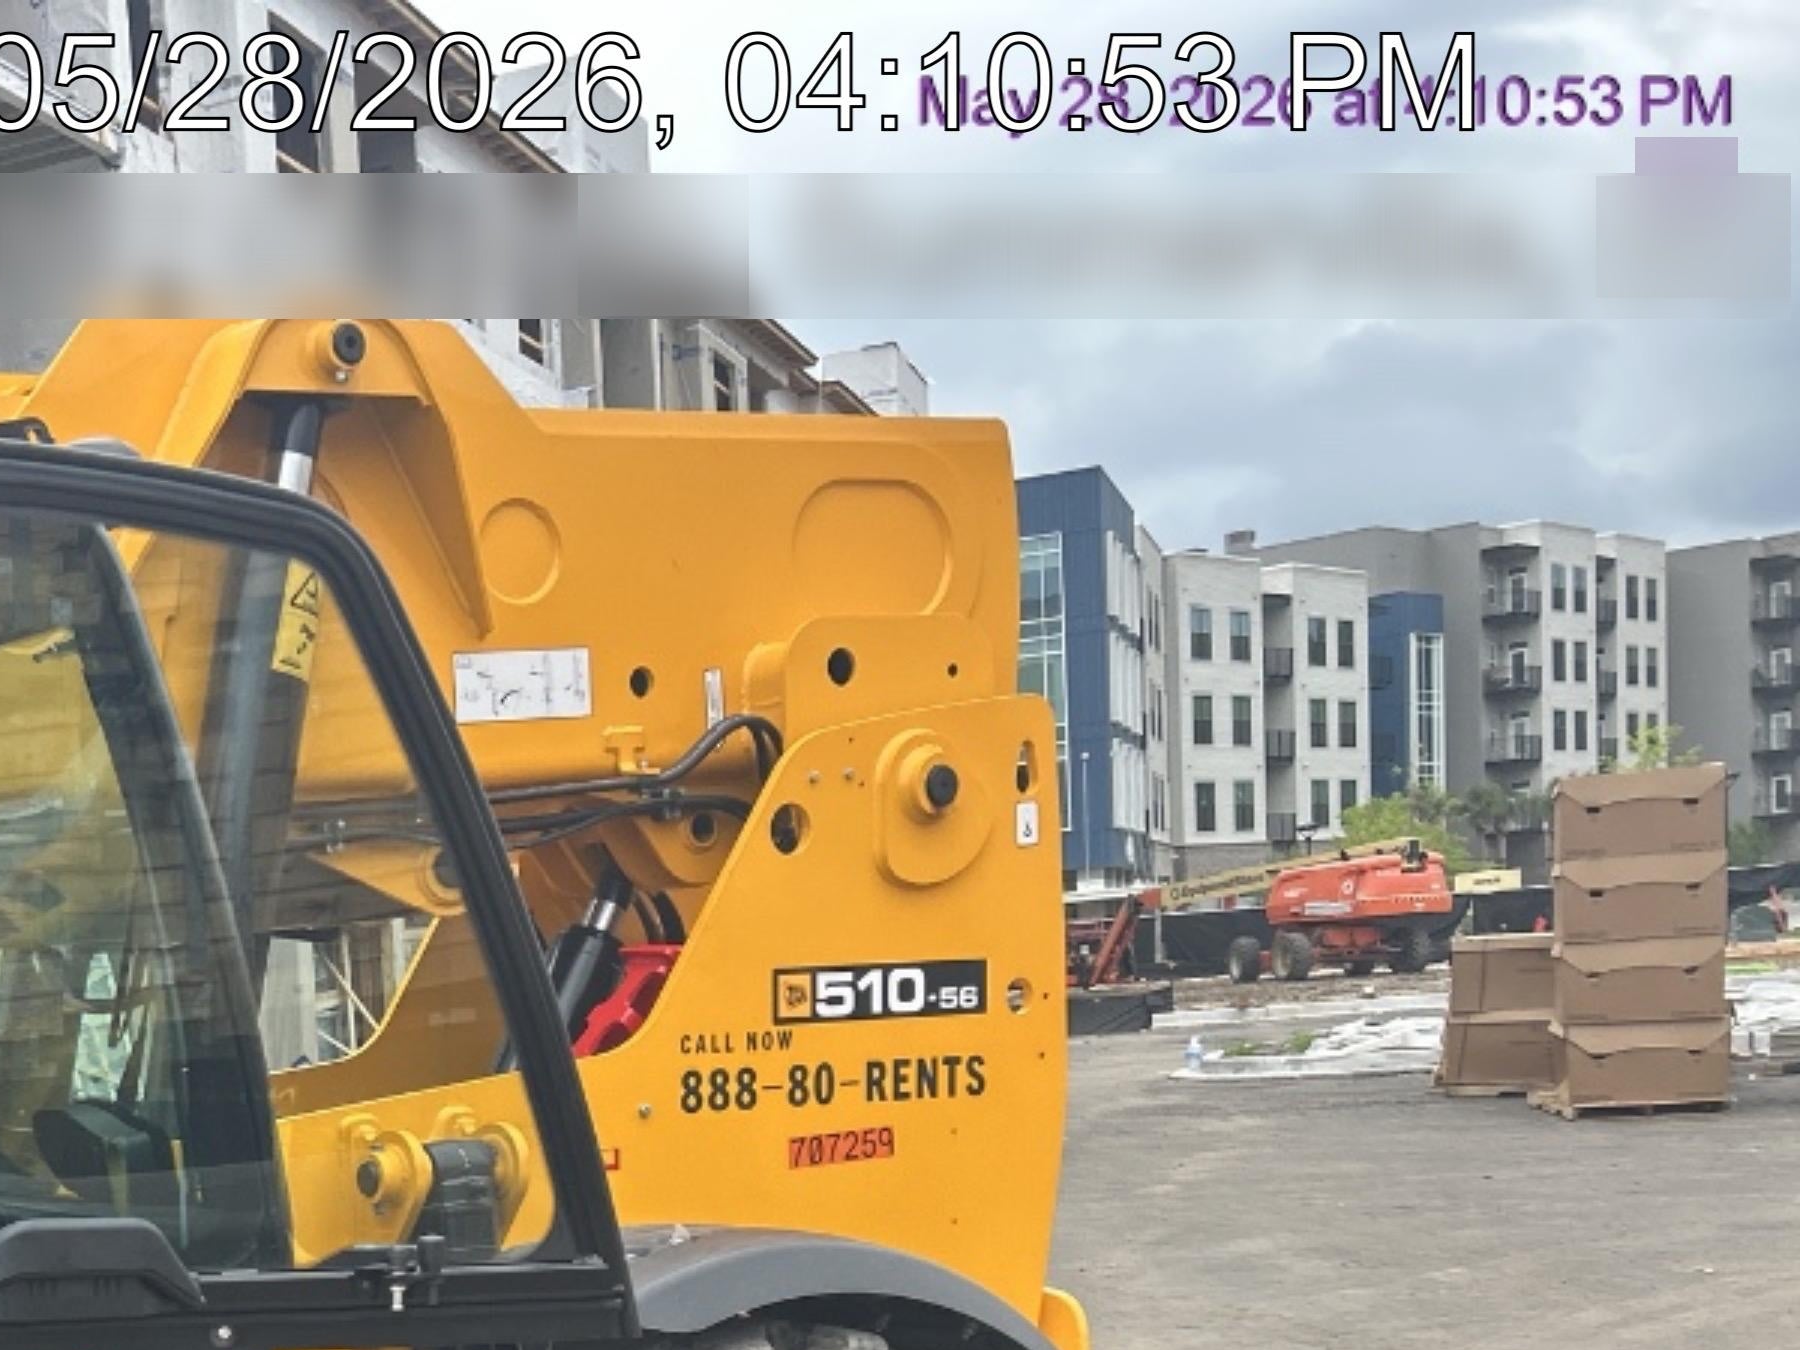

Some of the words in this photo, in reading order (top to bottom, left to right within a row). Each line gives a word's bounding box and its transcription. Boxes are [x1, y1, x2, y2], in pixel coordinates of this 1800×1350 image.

[680, 1033, 735, 1054] CALL
[746, 1030, 793, 1051] NOW
[680, 1055, 986, 1113] 888-80-RENTS
[790, 1126, 895, 1168] 707259
